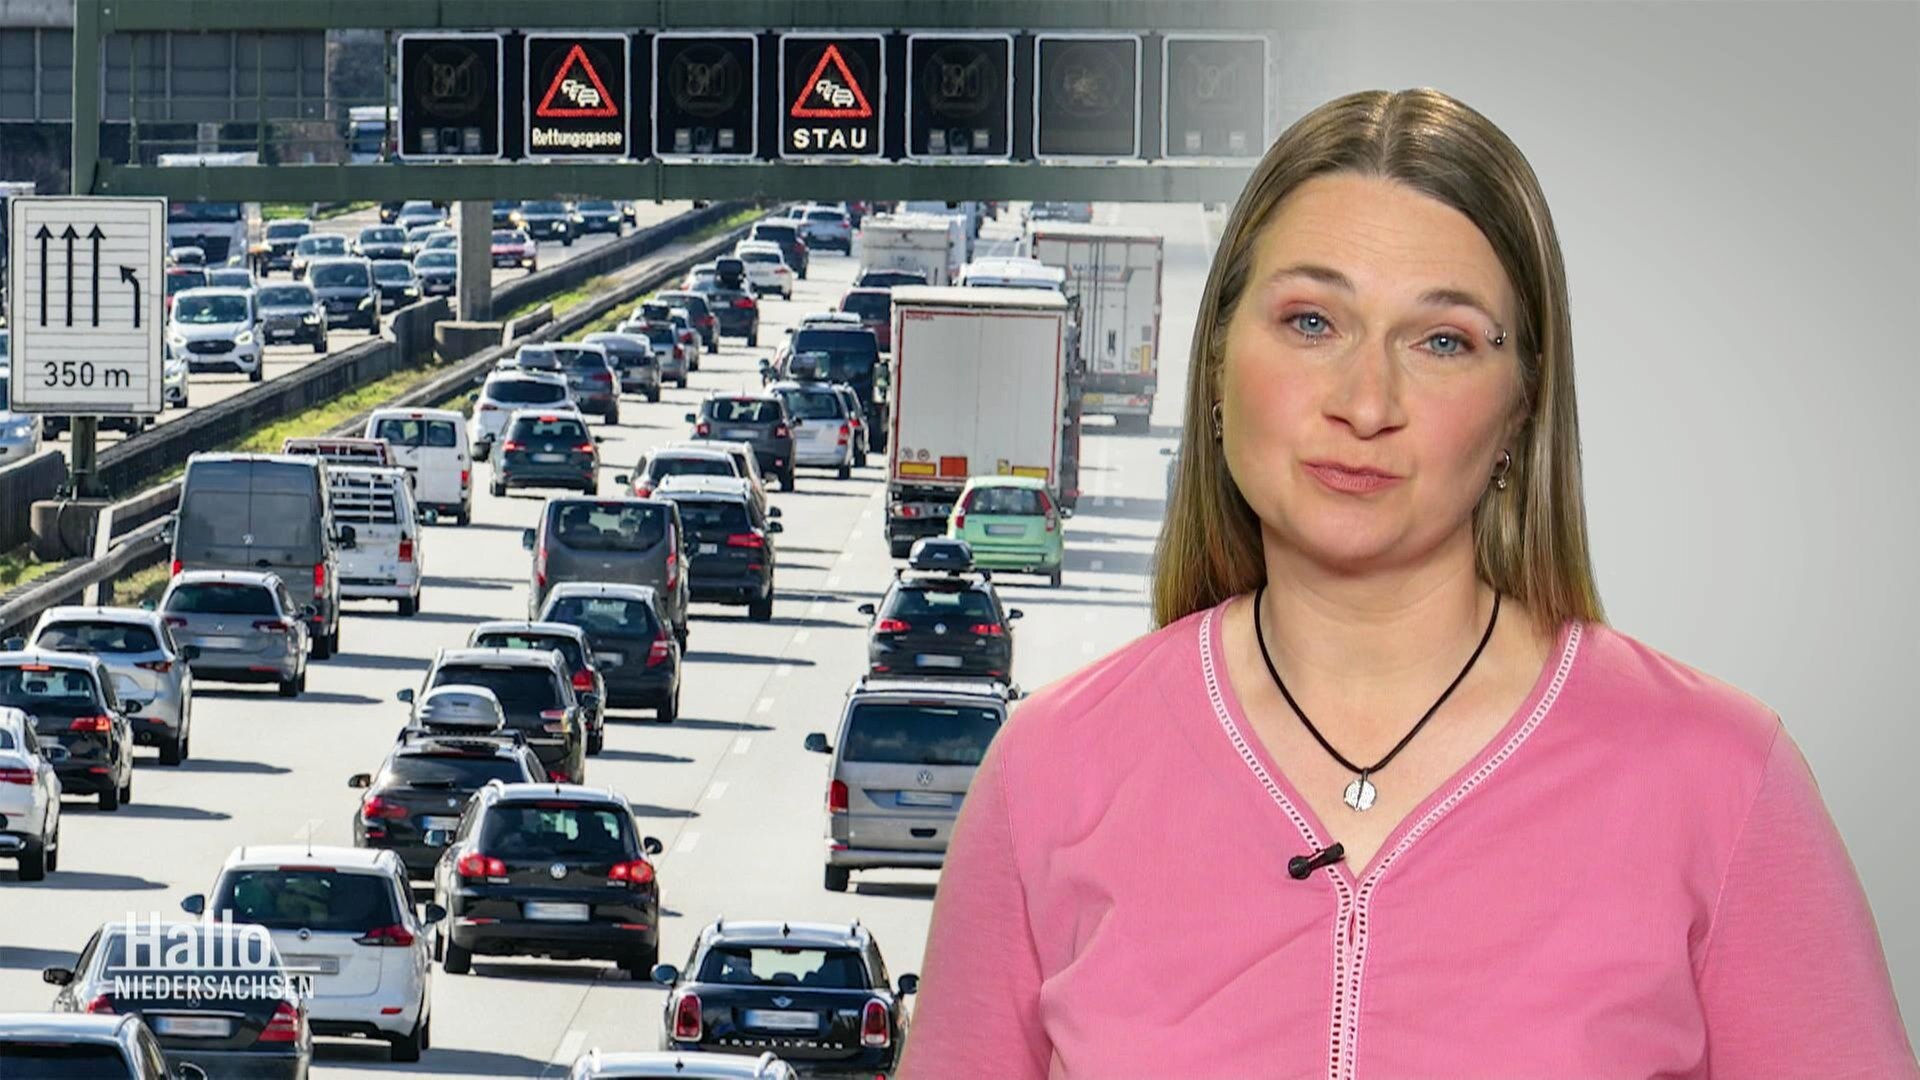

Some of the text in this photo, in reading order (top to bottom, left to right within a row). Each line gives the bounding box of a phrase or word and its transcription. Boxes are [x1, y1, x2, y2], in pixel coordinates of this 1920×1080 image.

[532, 127, 622, 148] Rettungsgasse
[793, 128, 867, 149] STAU
[44, 361, 131, 388] 350 m
